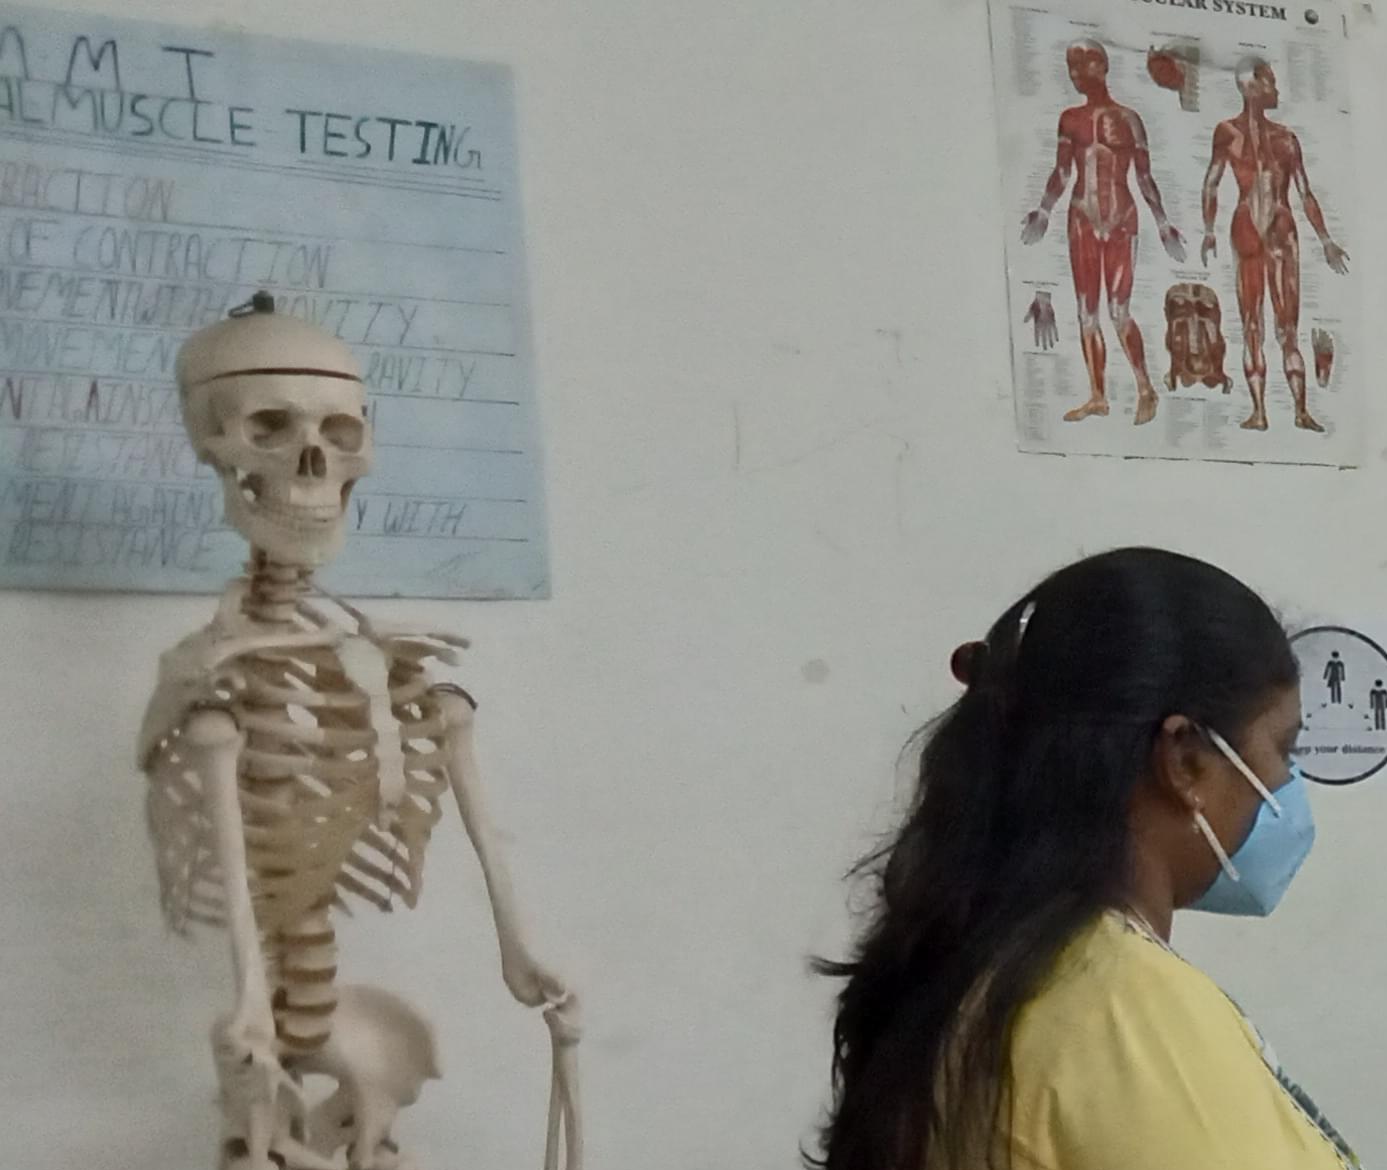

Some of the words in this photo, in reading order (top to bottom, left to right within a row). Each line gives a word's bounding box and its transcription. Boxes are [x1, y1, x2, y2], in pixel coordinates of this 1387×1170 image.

[1212, 0, 1288, 21] SYSTEM
[51, 87, 256, 147] MUSCLE
[284, 108, 485, 169] TESTING
[72, 224, 334, 288] CONTRACTION
[362, 351, 477, 399] RAVITY
[382, 500, 467, 537] WITH
